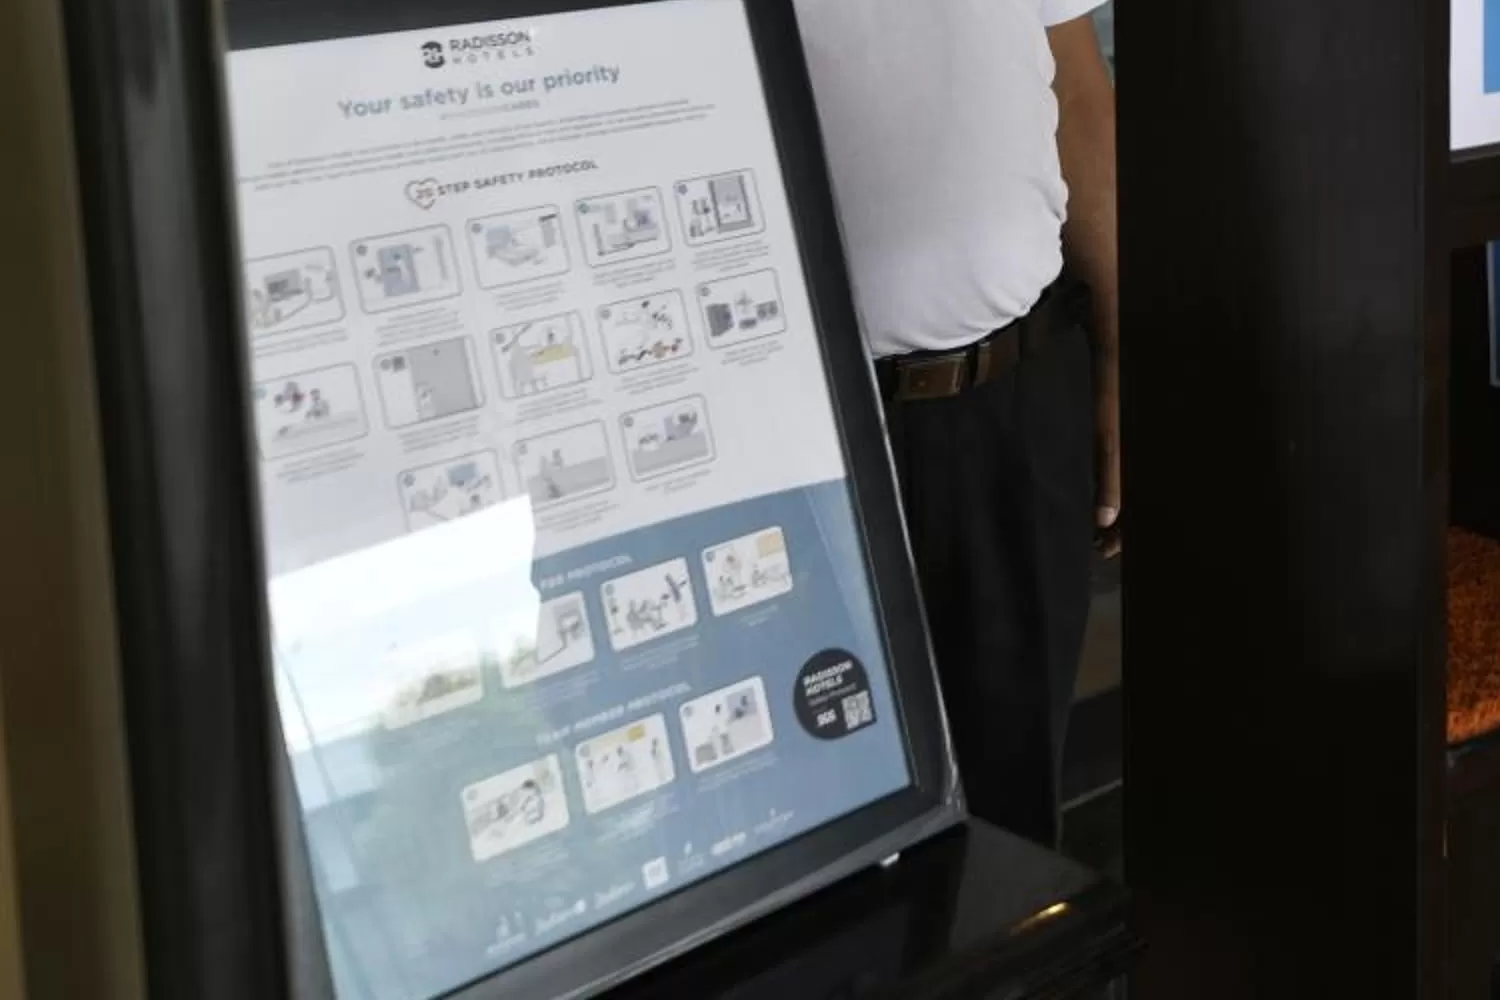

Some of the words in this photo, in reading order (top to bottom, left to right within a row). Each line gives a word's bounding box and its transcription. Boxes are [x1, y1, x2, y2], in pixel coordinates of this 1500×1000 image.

[448, 30, 532, 51] RADISSON
[337, 98, 392, 120] Your
[400, 85, 469, 110] safety
[476, 81, 494, 99] is
[500, 78, 536, 96] our
[543, 64, 620, 93] priority
[437, 180, 470, 197] STEP
[473, 172, 523, 189] SAFETY
[528, 160, 599, 179] PROTOCOL
